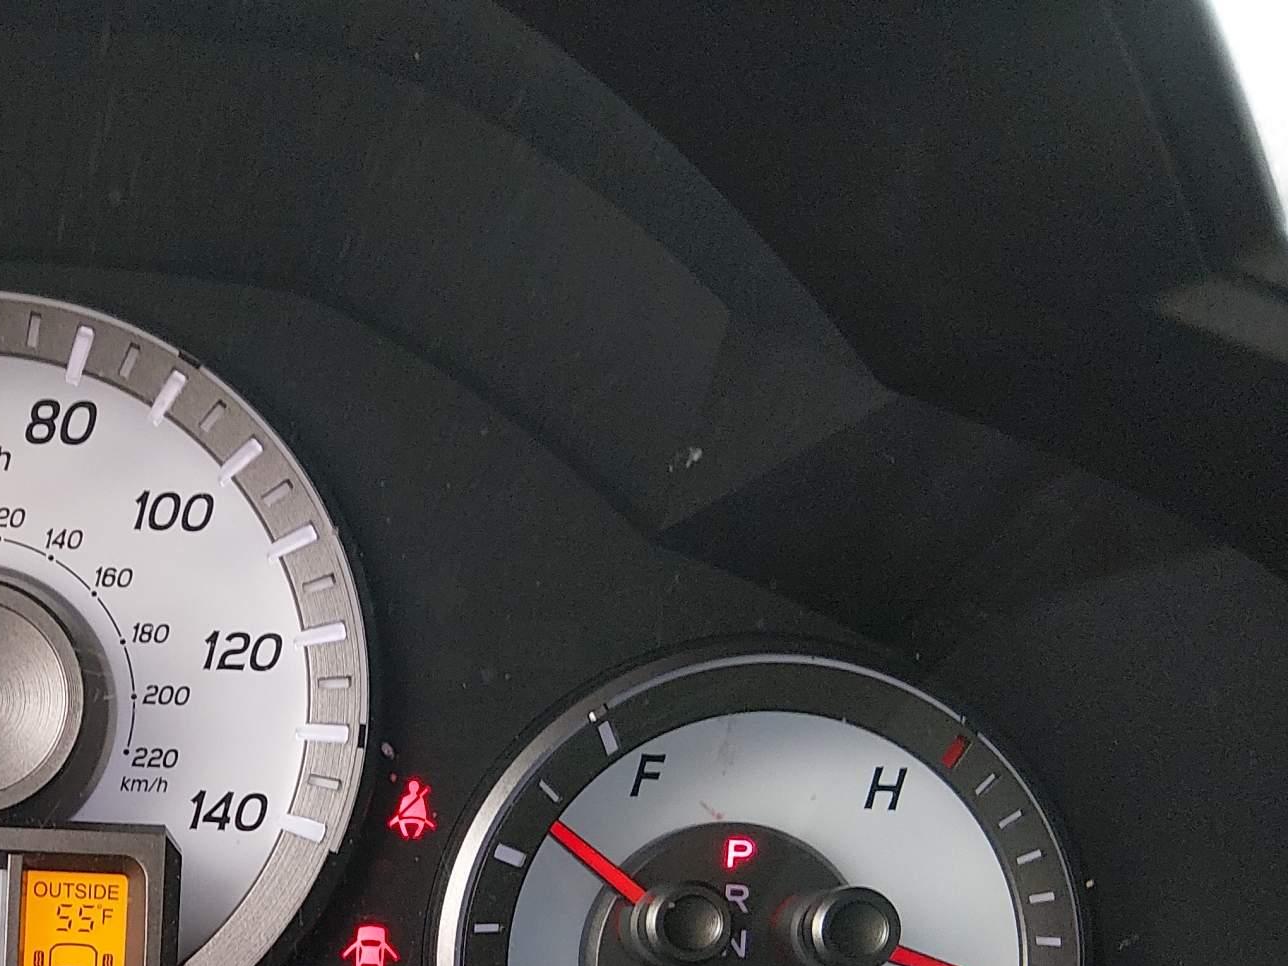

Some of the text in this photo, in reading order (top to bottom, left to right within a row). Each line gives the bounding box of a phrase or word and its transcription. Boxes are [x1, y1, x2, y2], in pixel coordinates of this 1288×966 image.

[24, 400, 97, 446] 80
[133, 490, 214, 532] 100
[45, 528, 83, 550] 140
[94, 566, 133, 588] 160
[131, 621, 171, 644] 180
[202, 631, 283, 672] 120
[142, 685, 190, 706] 200
[130, 748, 179, 770] 220
[119, 774, 169, 795] km/h
[630, 753, 666, 797] F
[864, 767, 907, 811] H
[189, 791, 268, 832] 140
[726, 839, 754, 868] P
[33, 881, 120, 900] OUTSIDE
[725, 884, 749, 913] R
